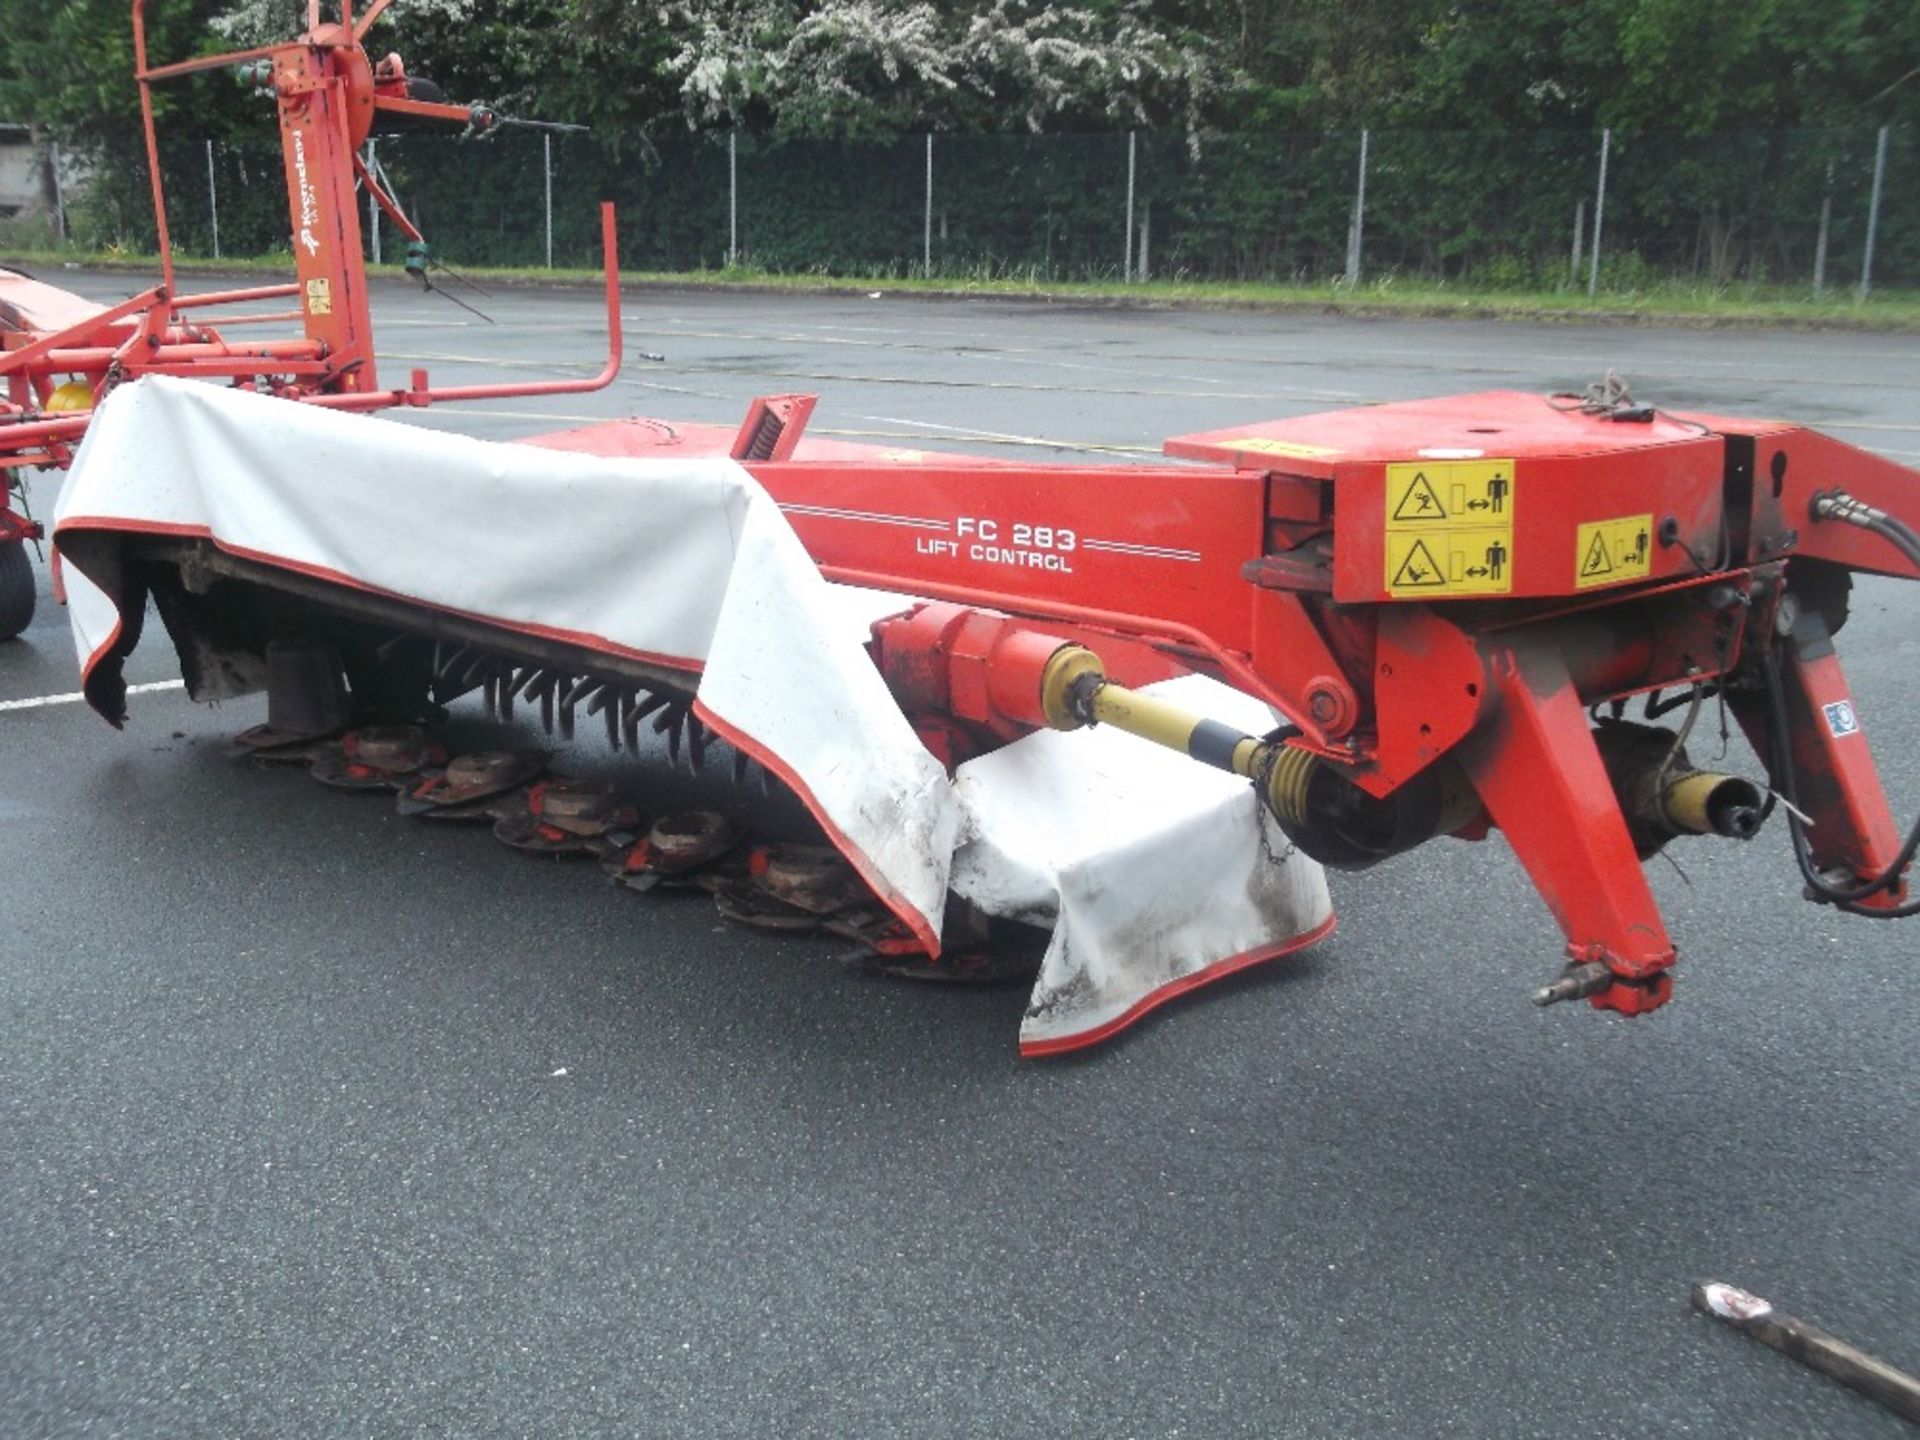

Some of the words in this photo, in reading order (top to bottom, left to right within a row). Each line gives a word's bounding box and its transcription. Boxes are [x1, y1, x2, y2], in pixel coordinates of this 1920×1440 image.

[916, 537, 959, 557] LIFT
[956, 516, 998, 541] FC
[1012, 523, 1077, 551] 283
